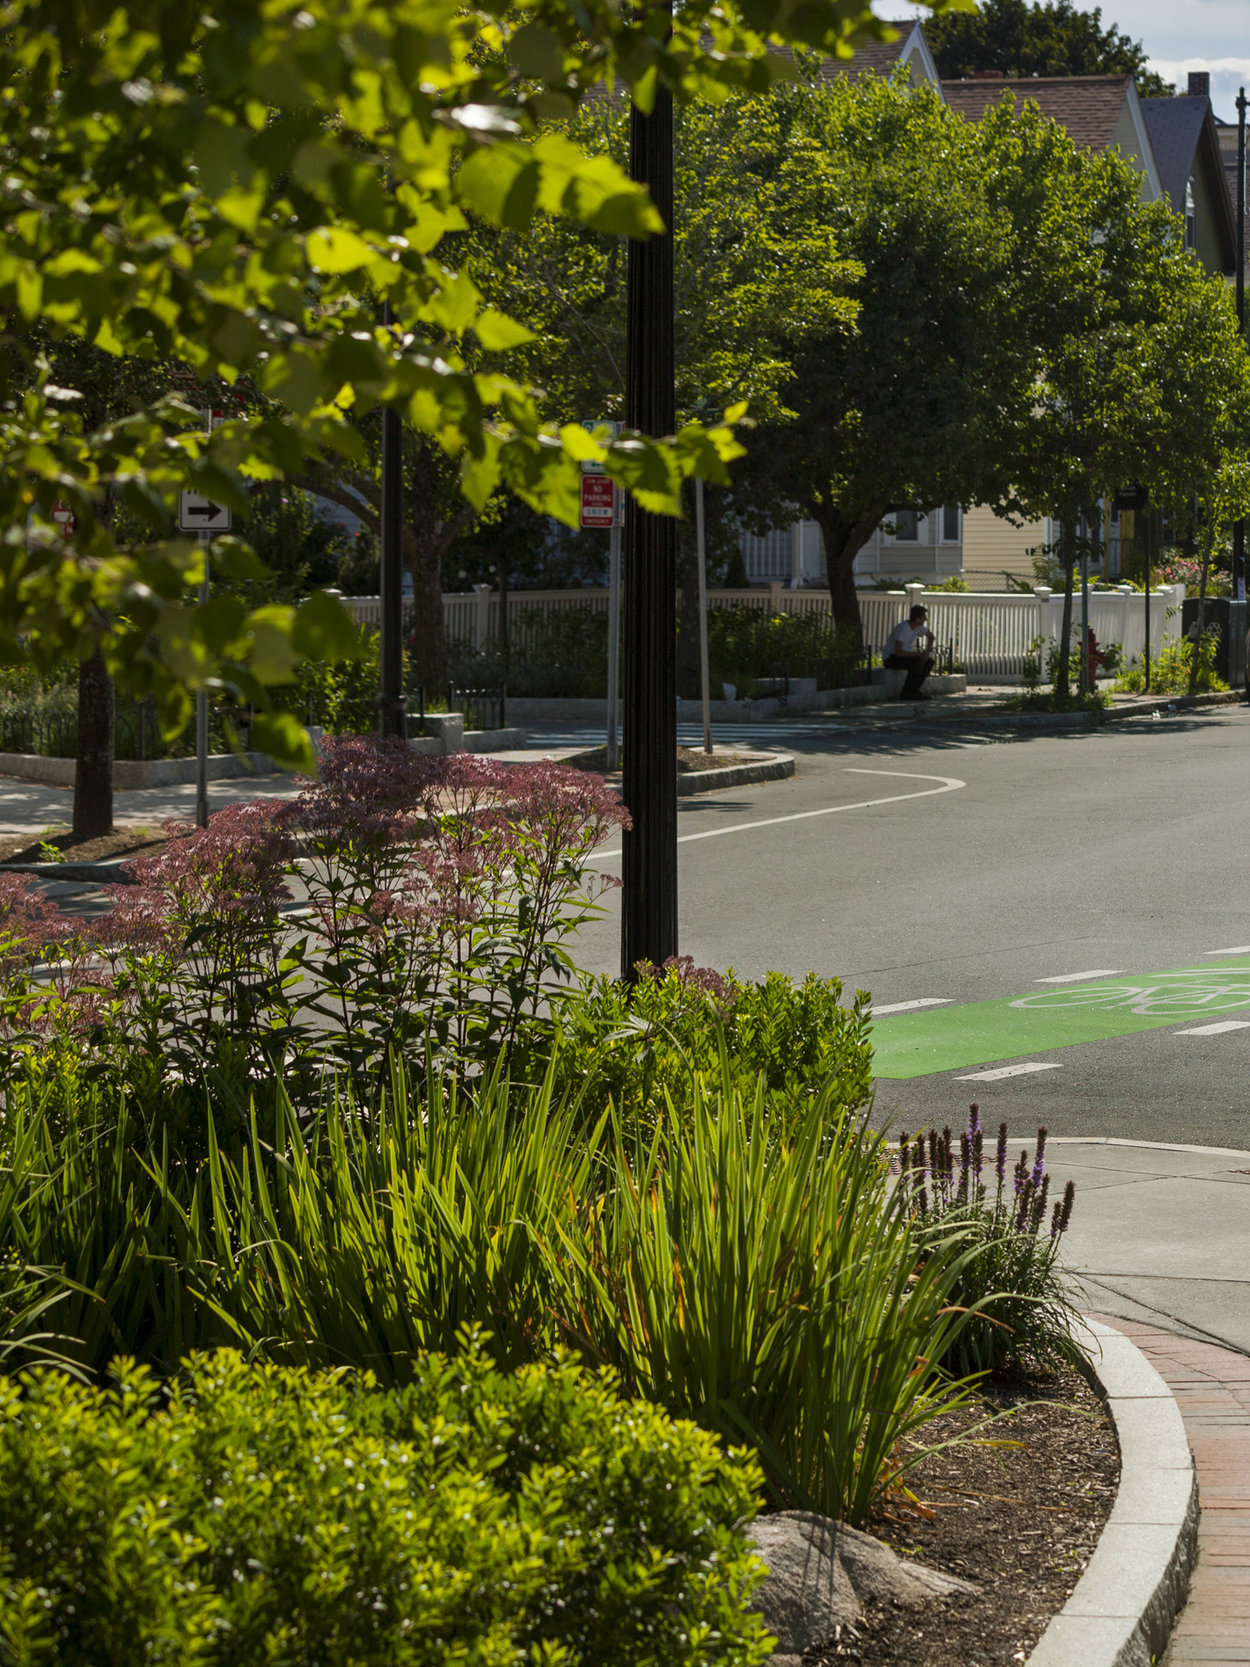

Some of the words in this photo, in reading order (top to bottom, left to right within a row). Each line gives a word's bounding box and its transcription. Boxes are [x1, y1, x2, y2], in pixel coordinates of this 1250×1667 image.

[593, 485, 603, 493] NO
[584, 494, 612, 502] PARKING
[586, 508, 609, 516] SNOW
